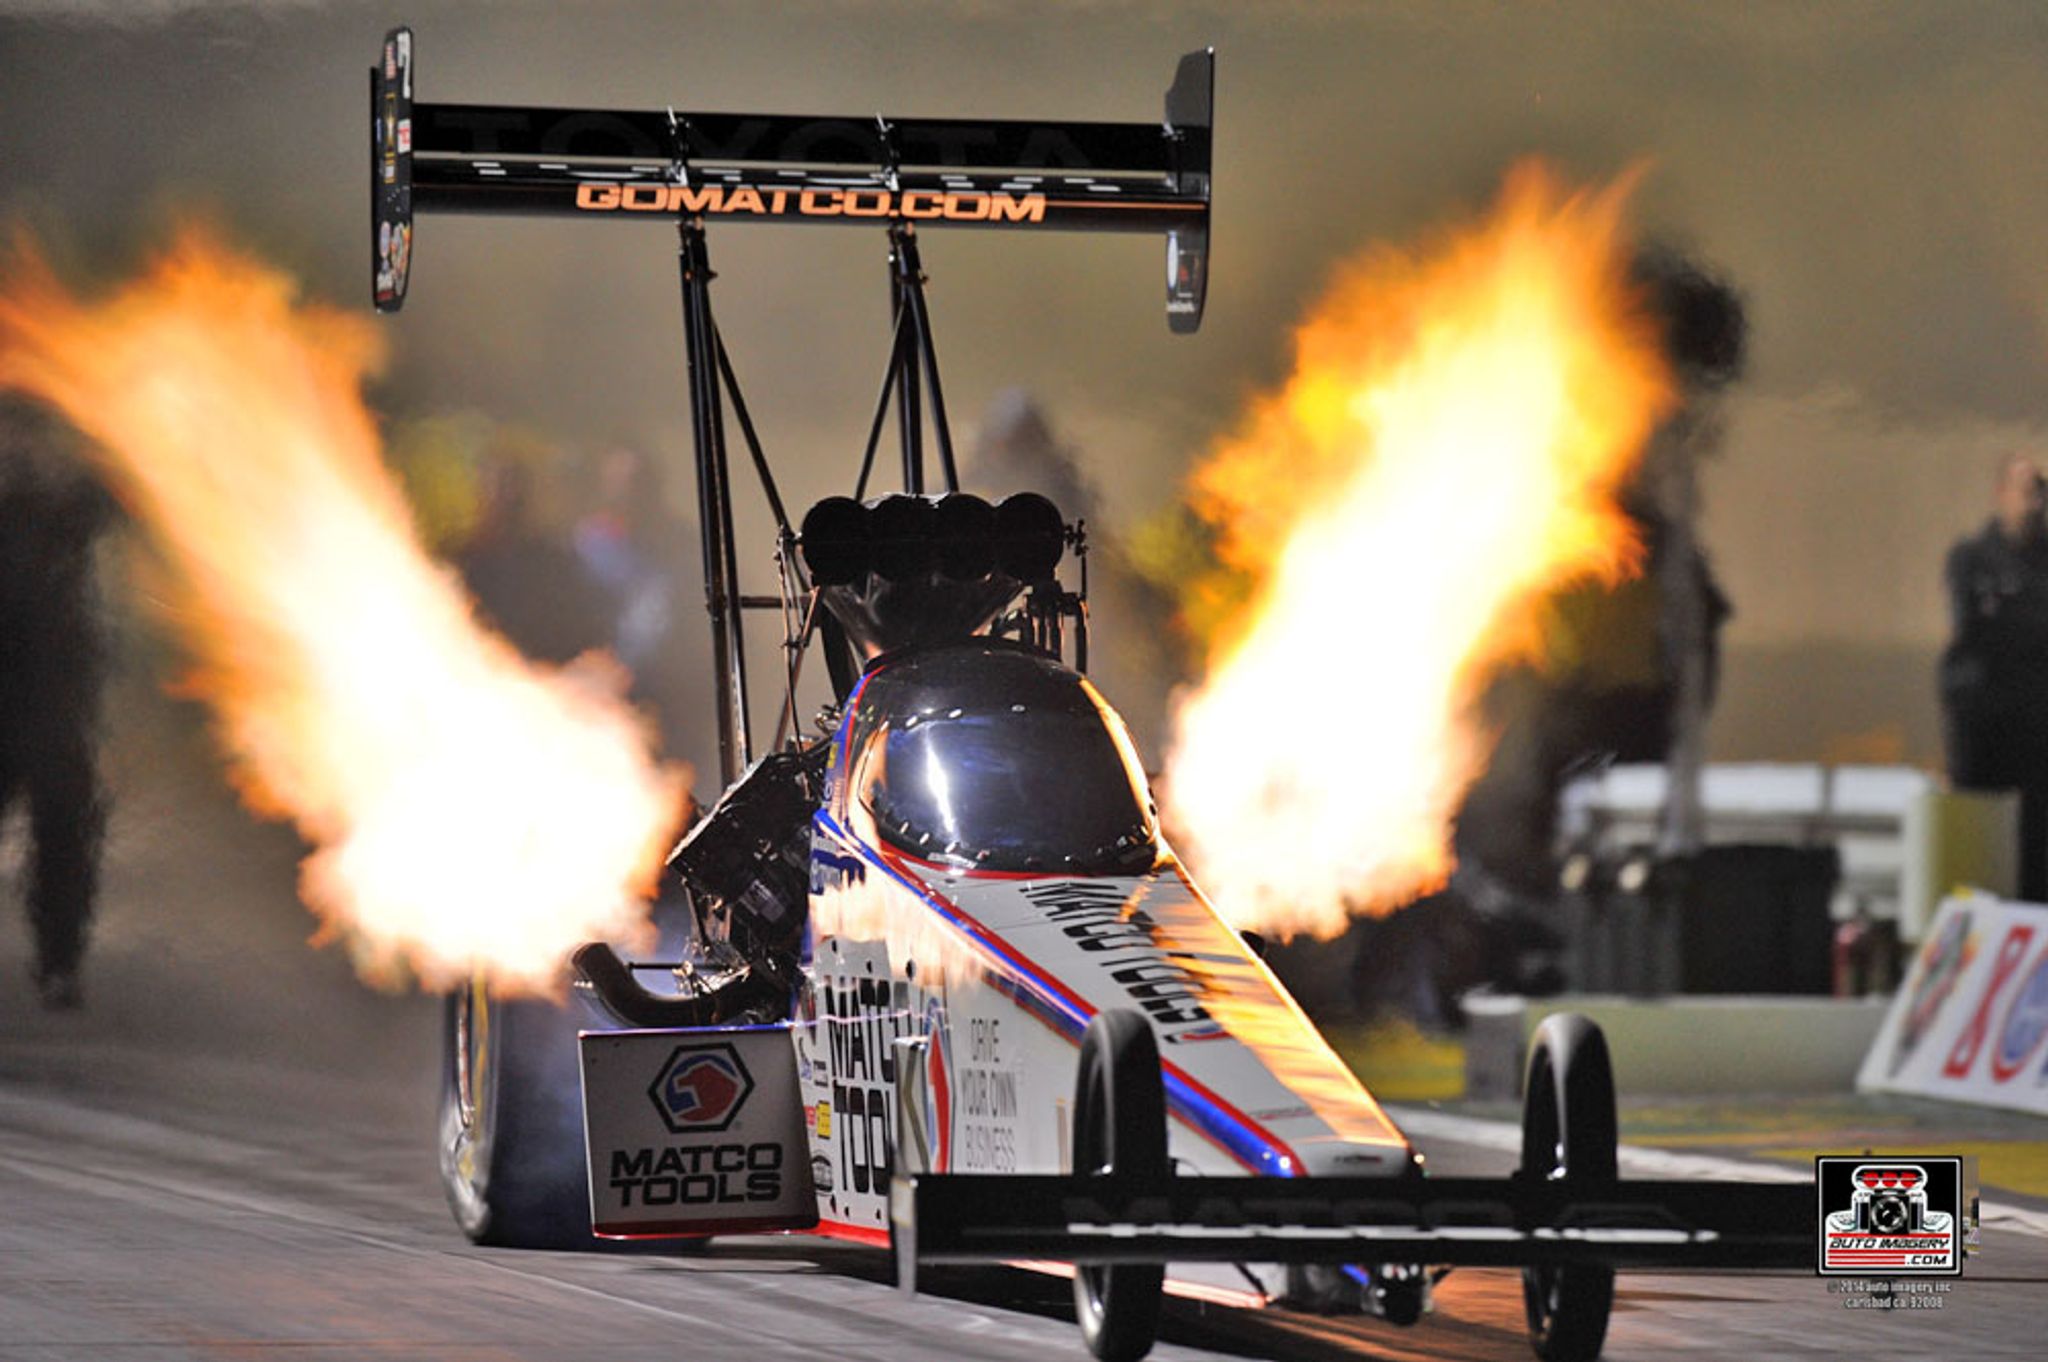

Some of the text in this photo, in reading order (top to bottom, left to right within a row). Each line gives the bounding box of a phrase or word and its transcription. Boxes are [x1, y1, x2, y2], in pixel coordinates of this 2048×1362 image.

[576, 183, 1047, 223] GOMATCO.COM
[961, 1067, 1017, 1118] YOUR OWN
[609, 1143, 783, 1178] MATCO
[966, 1124, 1016, 1173] BUSINESS
[610, 1172, 782, 1208] TOOLS
